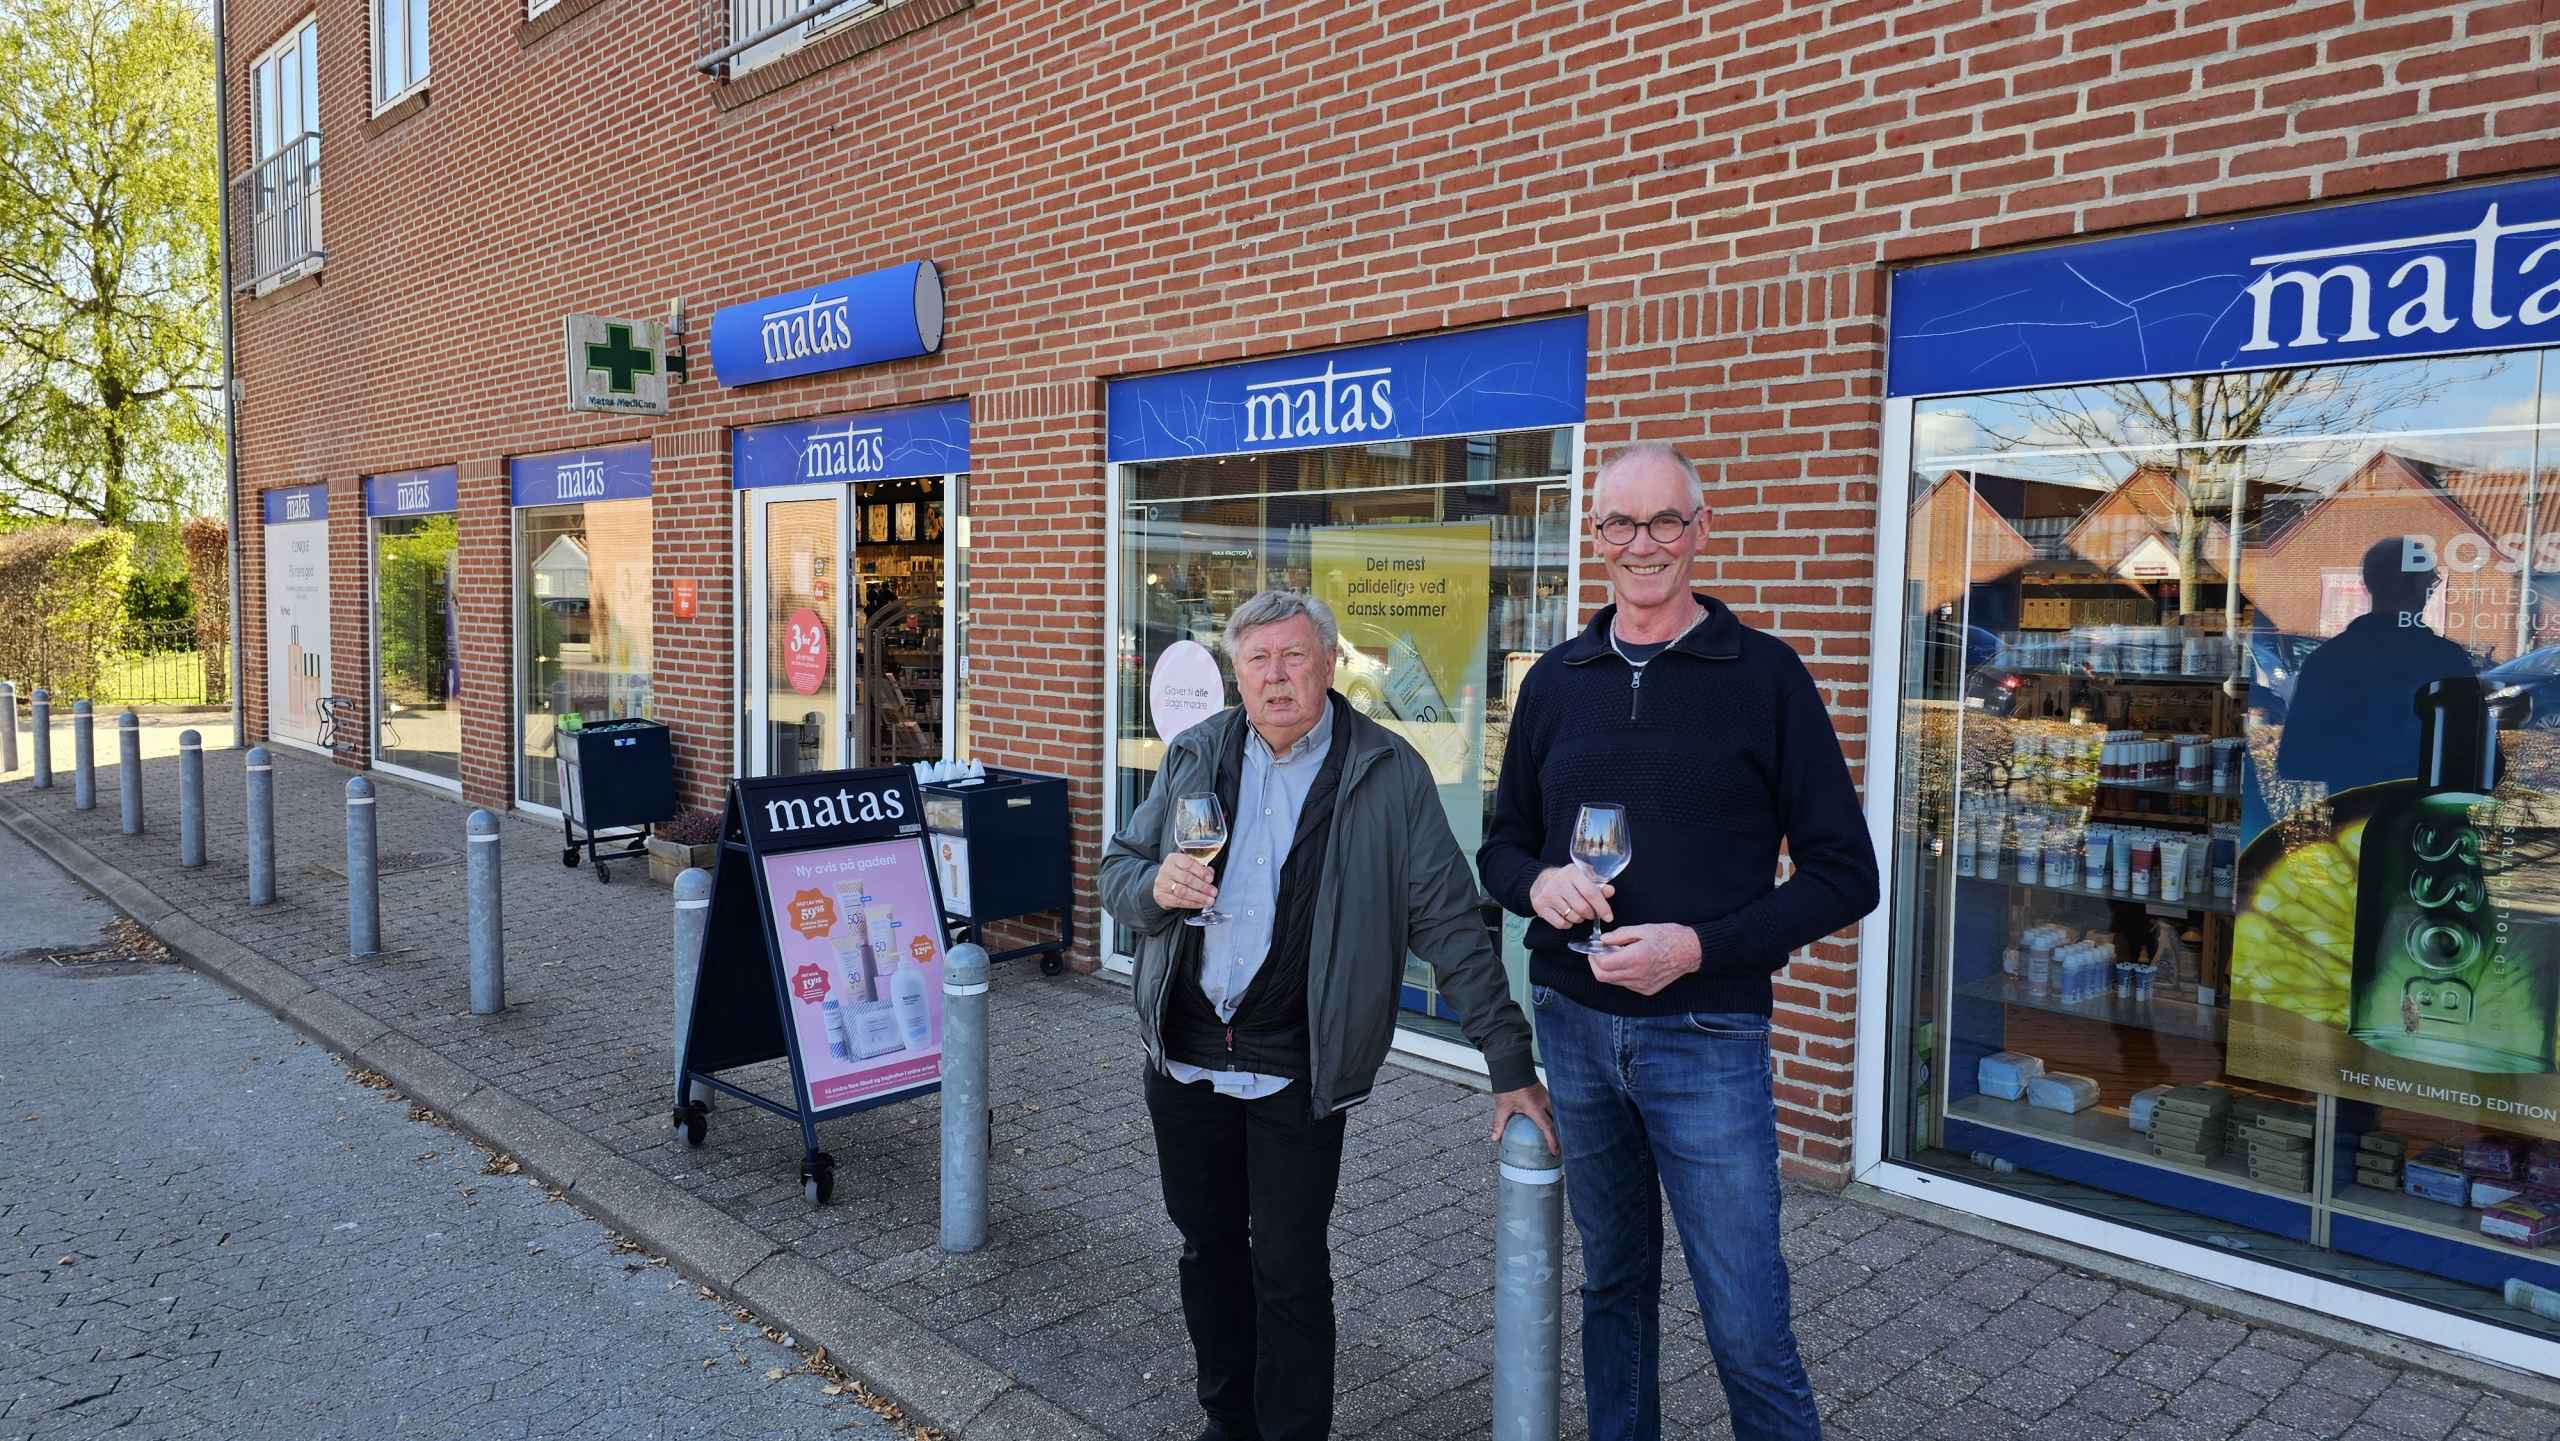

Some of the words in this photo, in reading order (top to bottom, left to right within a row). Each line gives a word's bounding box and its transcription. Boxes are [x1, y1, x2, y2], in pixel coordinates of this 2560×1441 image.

[761, 292, 852, 365] matas
[616, 398, 657, 410] MediCare
[1243, 360, 1393, 443] matas
[806, 421, 884, 478] matas
[397, 475, 430, 511] matas
[557, 456, 605, 499] matas
[286, 489, 311, 520] matas
[1366, 556, 1388, 571] Det
[1392, 556, 1425, 571] mest
[2401, 532, 2560, 573] BOSS
[1347, 577, 1415, 597] pålidelige
[1419, 578, 1446, 594] ved
[1347, 601, 1386, 616] dansk
[1389, 604, 1447, 617] sommer
[2398, 611, 2465, 629] BOD
[791, 624, 801, 652] 3
[810, 626, 820, 655] 2
[1194, 688, 1209, 698] alle
[765, 788, 904, 832] matas
[795, 863, 812, 879] Ny
[815, 860, 838, 875] avis
[840, 858, 856, 873] på
[857, 853, 897, 872] gaden!
[2401, 821, 2486, 1025] BOSS
[2340, 1069, 2370, 1086] THE
[2374, 1075, 2413, 1094] NEW
[2417, 1084, 2481, 1107] LIMITED
[2486, 1097, 2558, 1122] EDITION
